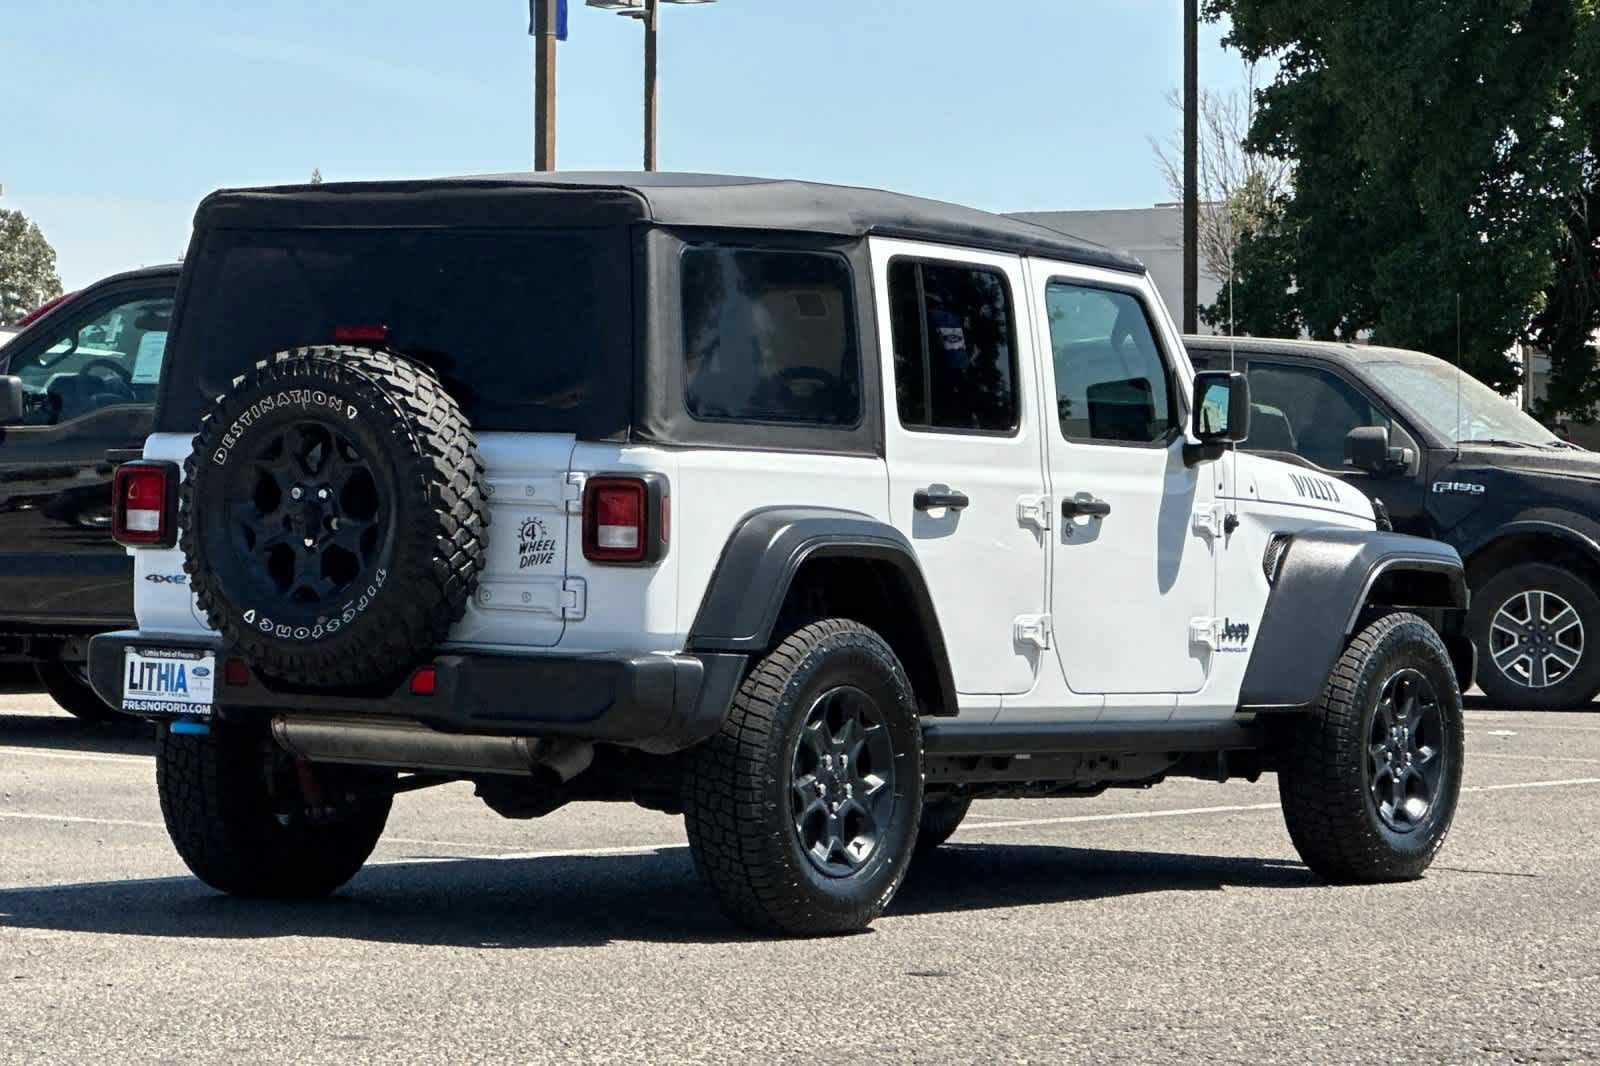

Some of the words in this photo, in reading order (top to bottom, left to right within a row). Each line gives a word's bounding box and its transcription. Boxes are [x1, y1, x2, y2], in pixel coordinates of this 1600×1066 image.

[213, 389, 343, 465] DESTINATION
[1288, 472, 1341, 502] WILLYS
[519, 540, 555, 554] WHEEL
[520, 553, 554, 568] DRIVE
[129, 662, 188, 693] LITHIA
[122, 700, 211, 714] FRESNOFORD.COM
